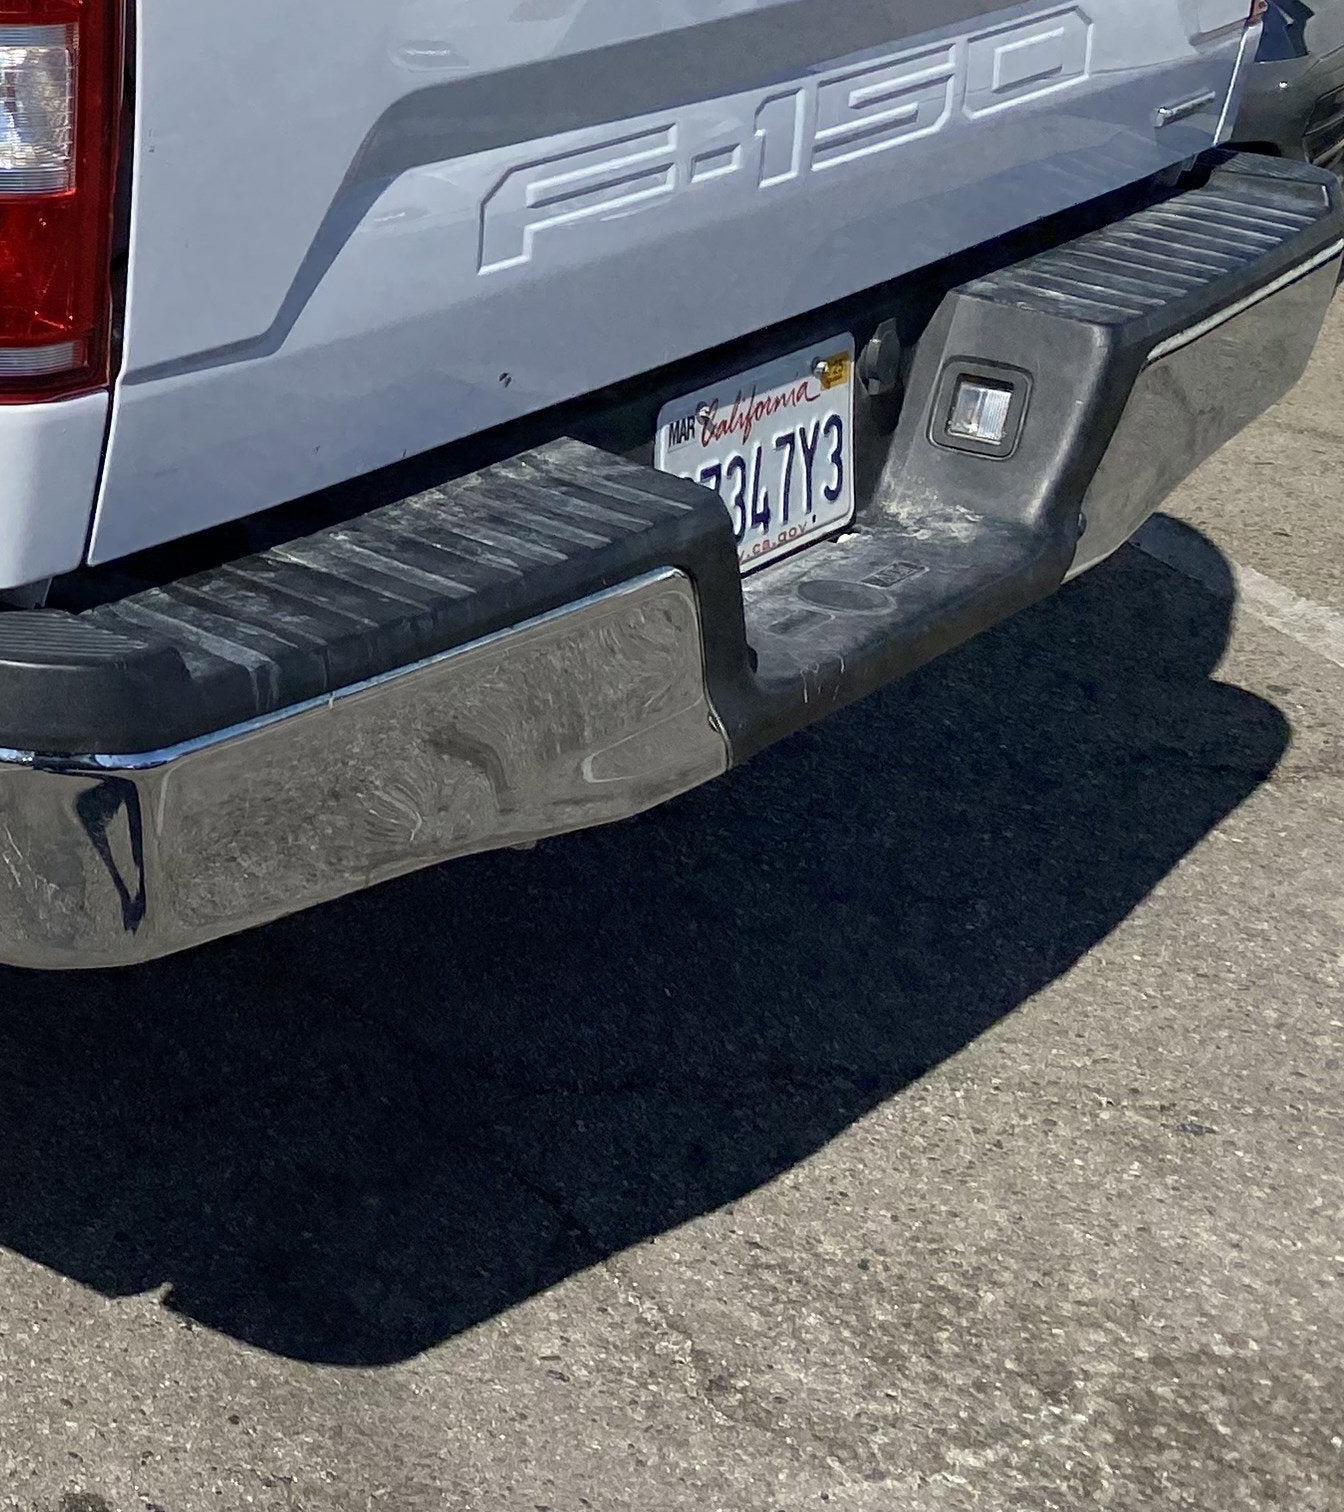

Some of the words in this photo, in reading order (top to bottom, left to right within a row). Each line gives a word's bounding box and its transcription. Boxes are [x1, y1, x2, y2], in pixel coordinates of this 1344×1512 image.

[477, 5, 1095, 276] F-150
[669, 415, 696, 448] MAR
[700, 380, 821, 448] California
